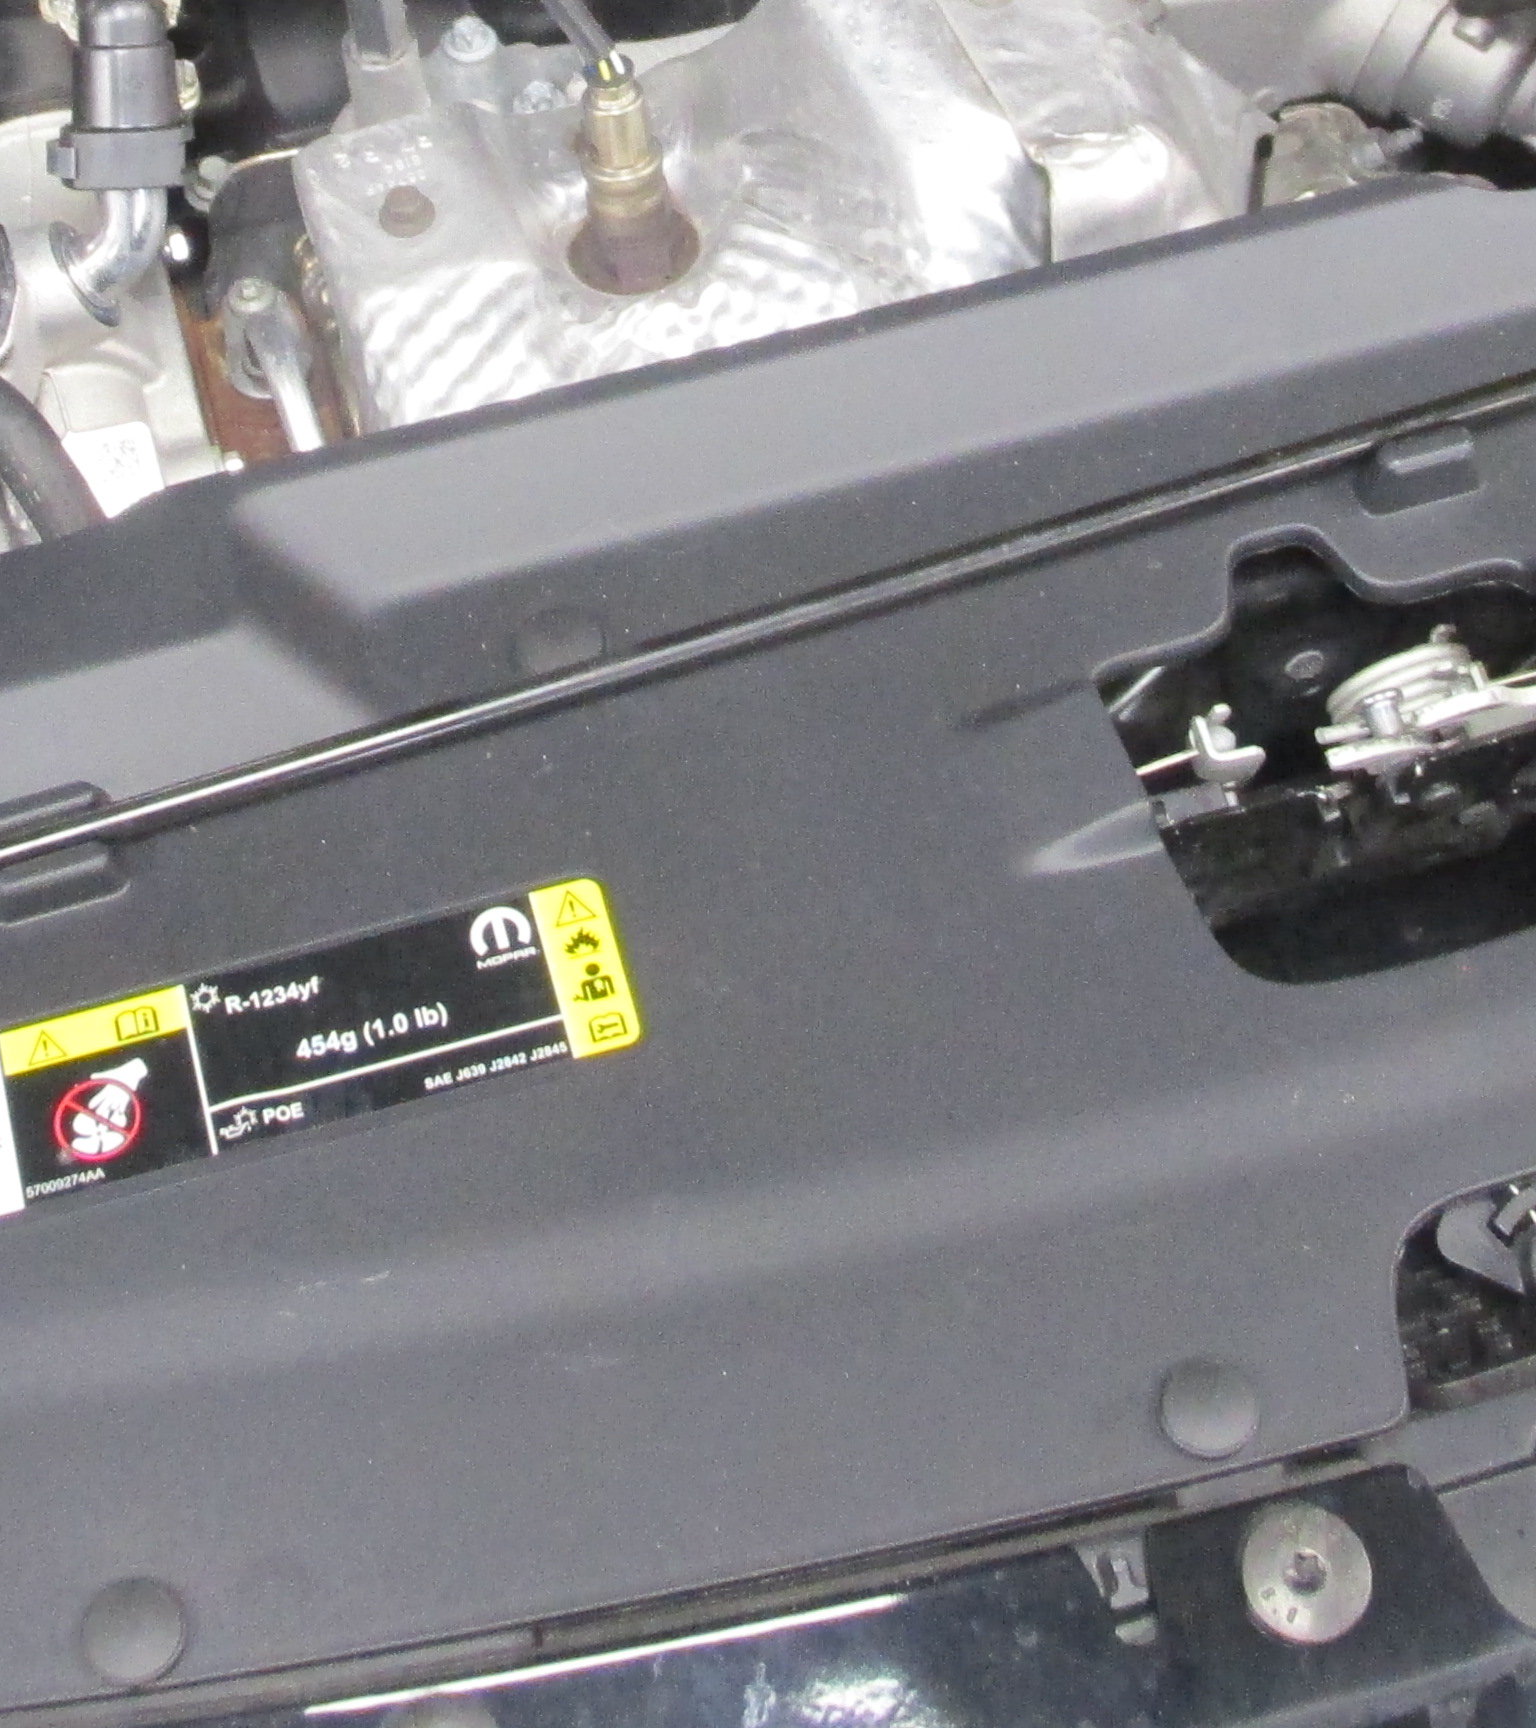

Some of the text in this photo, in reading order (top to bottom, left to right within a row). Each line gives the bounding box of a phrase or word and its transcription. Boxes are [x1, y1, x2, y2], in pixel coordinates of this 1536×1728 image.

[224, 976, 320, 1015] R-1234yf
[295, 1001, 450, 1061] 454g (1.0 lb)
[423, 1074, 454, 1090] SAE
[260, 1100, 306, 1126] POE
